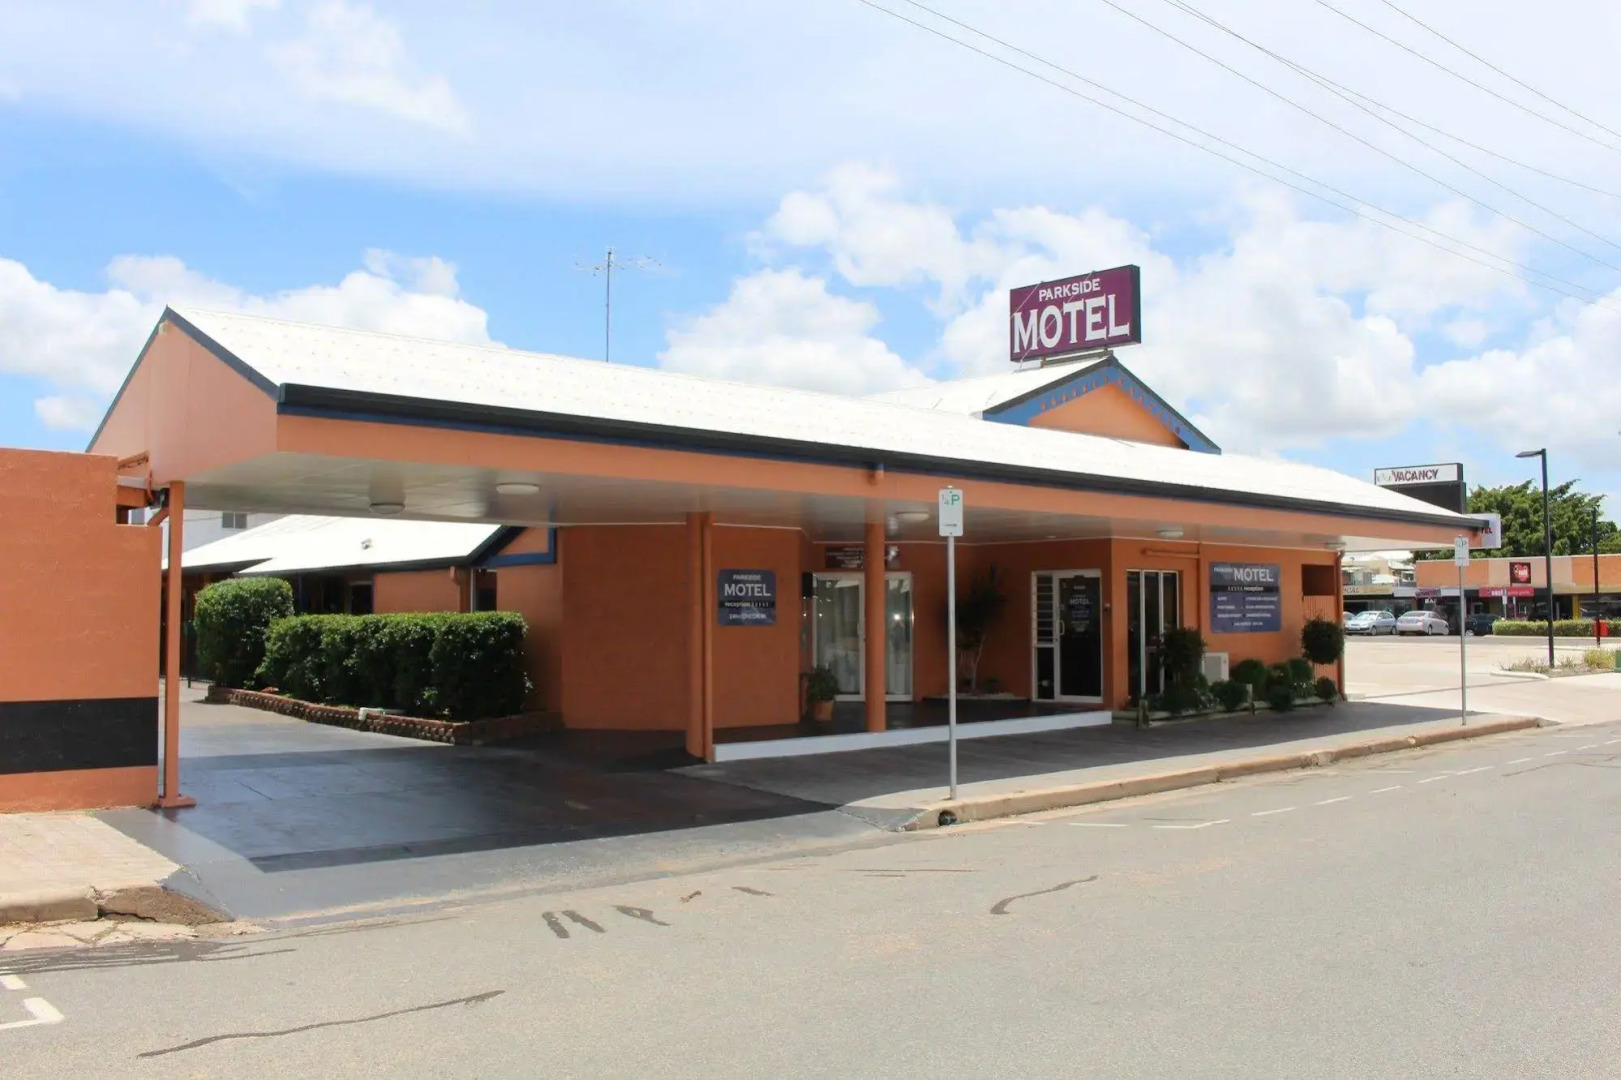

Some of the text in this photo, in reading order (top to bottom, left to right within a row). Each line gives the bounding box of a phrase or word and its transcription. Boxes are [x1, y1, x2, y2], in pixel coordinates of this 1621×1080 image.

[1039, 278, 1101, 301] PARKSIDE
[1013, 294, 1130, 353] MOTEL
[1392, 469, 1438, 482] VACANCY
[1234, 568, 1274, 582] MOTEL
[724, 584, 771, 596] MOTEL
